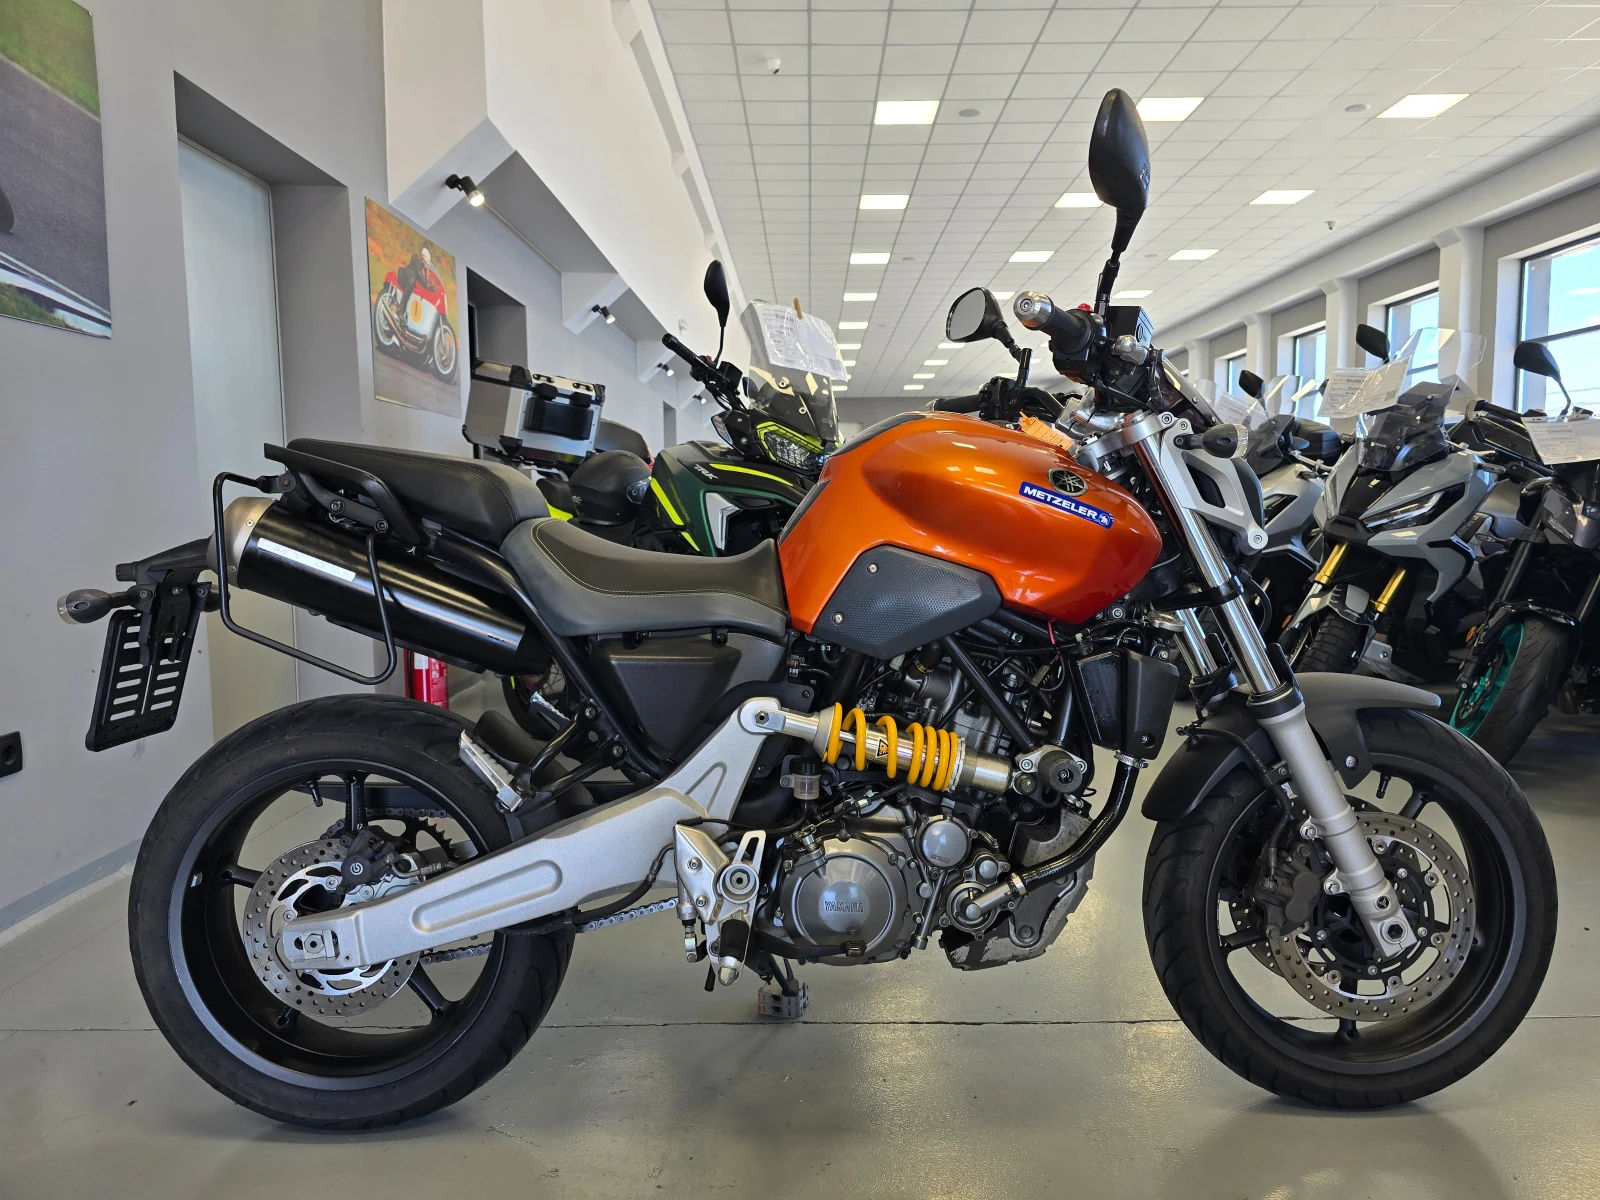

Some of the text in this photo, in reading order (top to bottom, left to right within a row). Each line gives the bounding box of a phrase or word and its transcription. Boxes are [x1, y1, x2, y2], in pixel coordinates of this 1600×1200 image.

[693, 463, 719, 480] TRK
[1023, 485, 1098, 520] METZELER
[824, 900, 864, 913] YAMAHA
